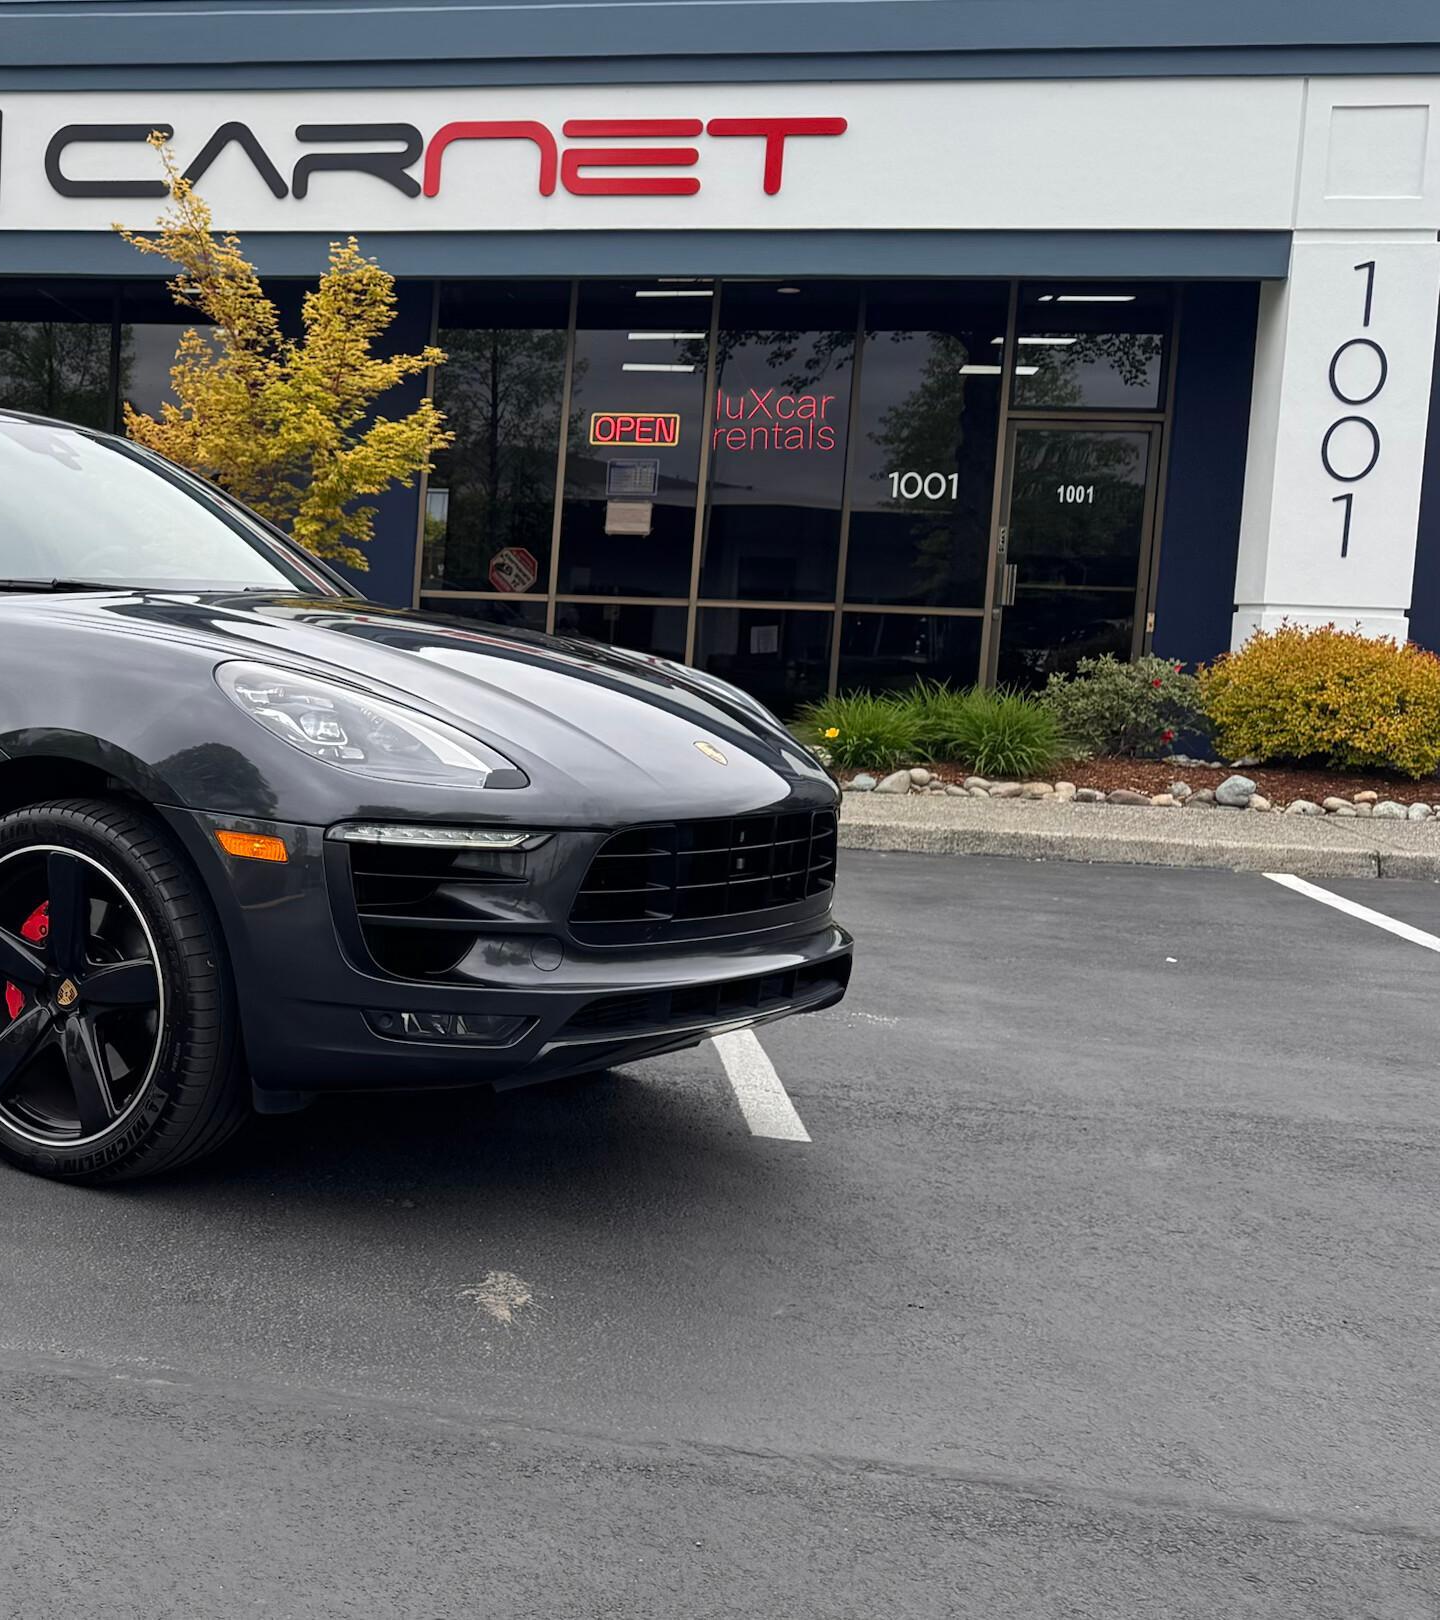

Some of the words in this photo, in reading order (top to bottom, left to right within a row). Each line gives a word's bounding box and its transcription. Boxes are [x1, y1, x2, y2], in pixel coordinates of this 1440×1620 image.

[715, 388, 836, 419] luXcar
[1321, 260, 1388, 558] 1001
[594, 416, 675, 442] OPEN
[713, 421, 836, 450] rentals
[889, 471, 958, 500] 1001
[1057, 485, 1094, 504] 1001
[64, 1115, 150, 1173] MICHELIN
